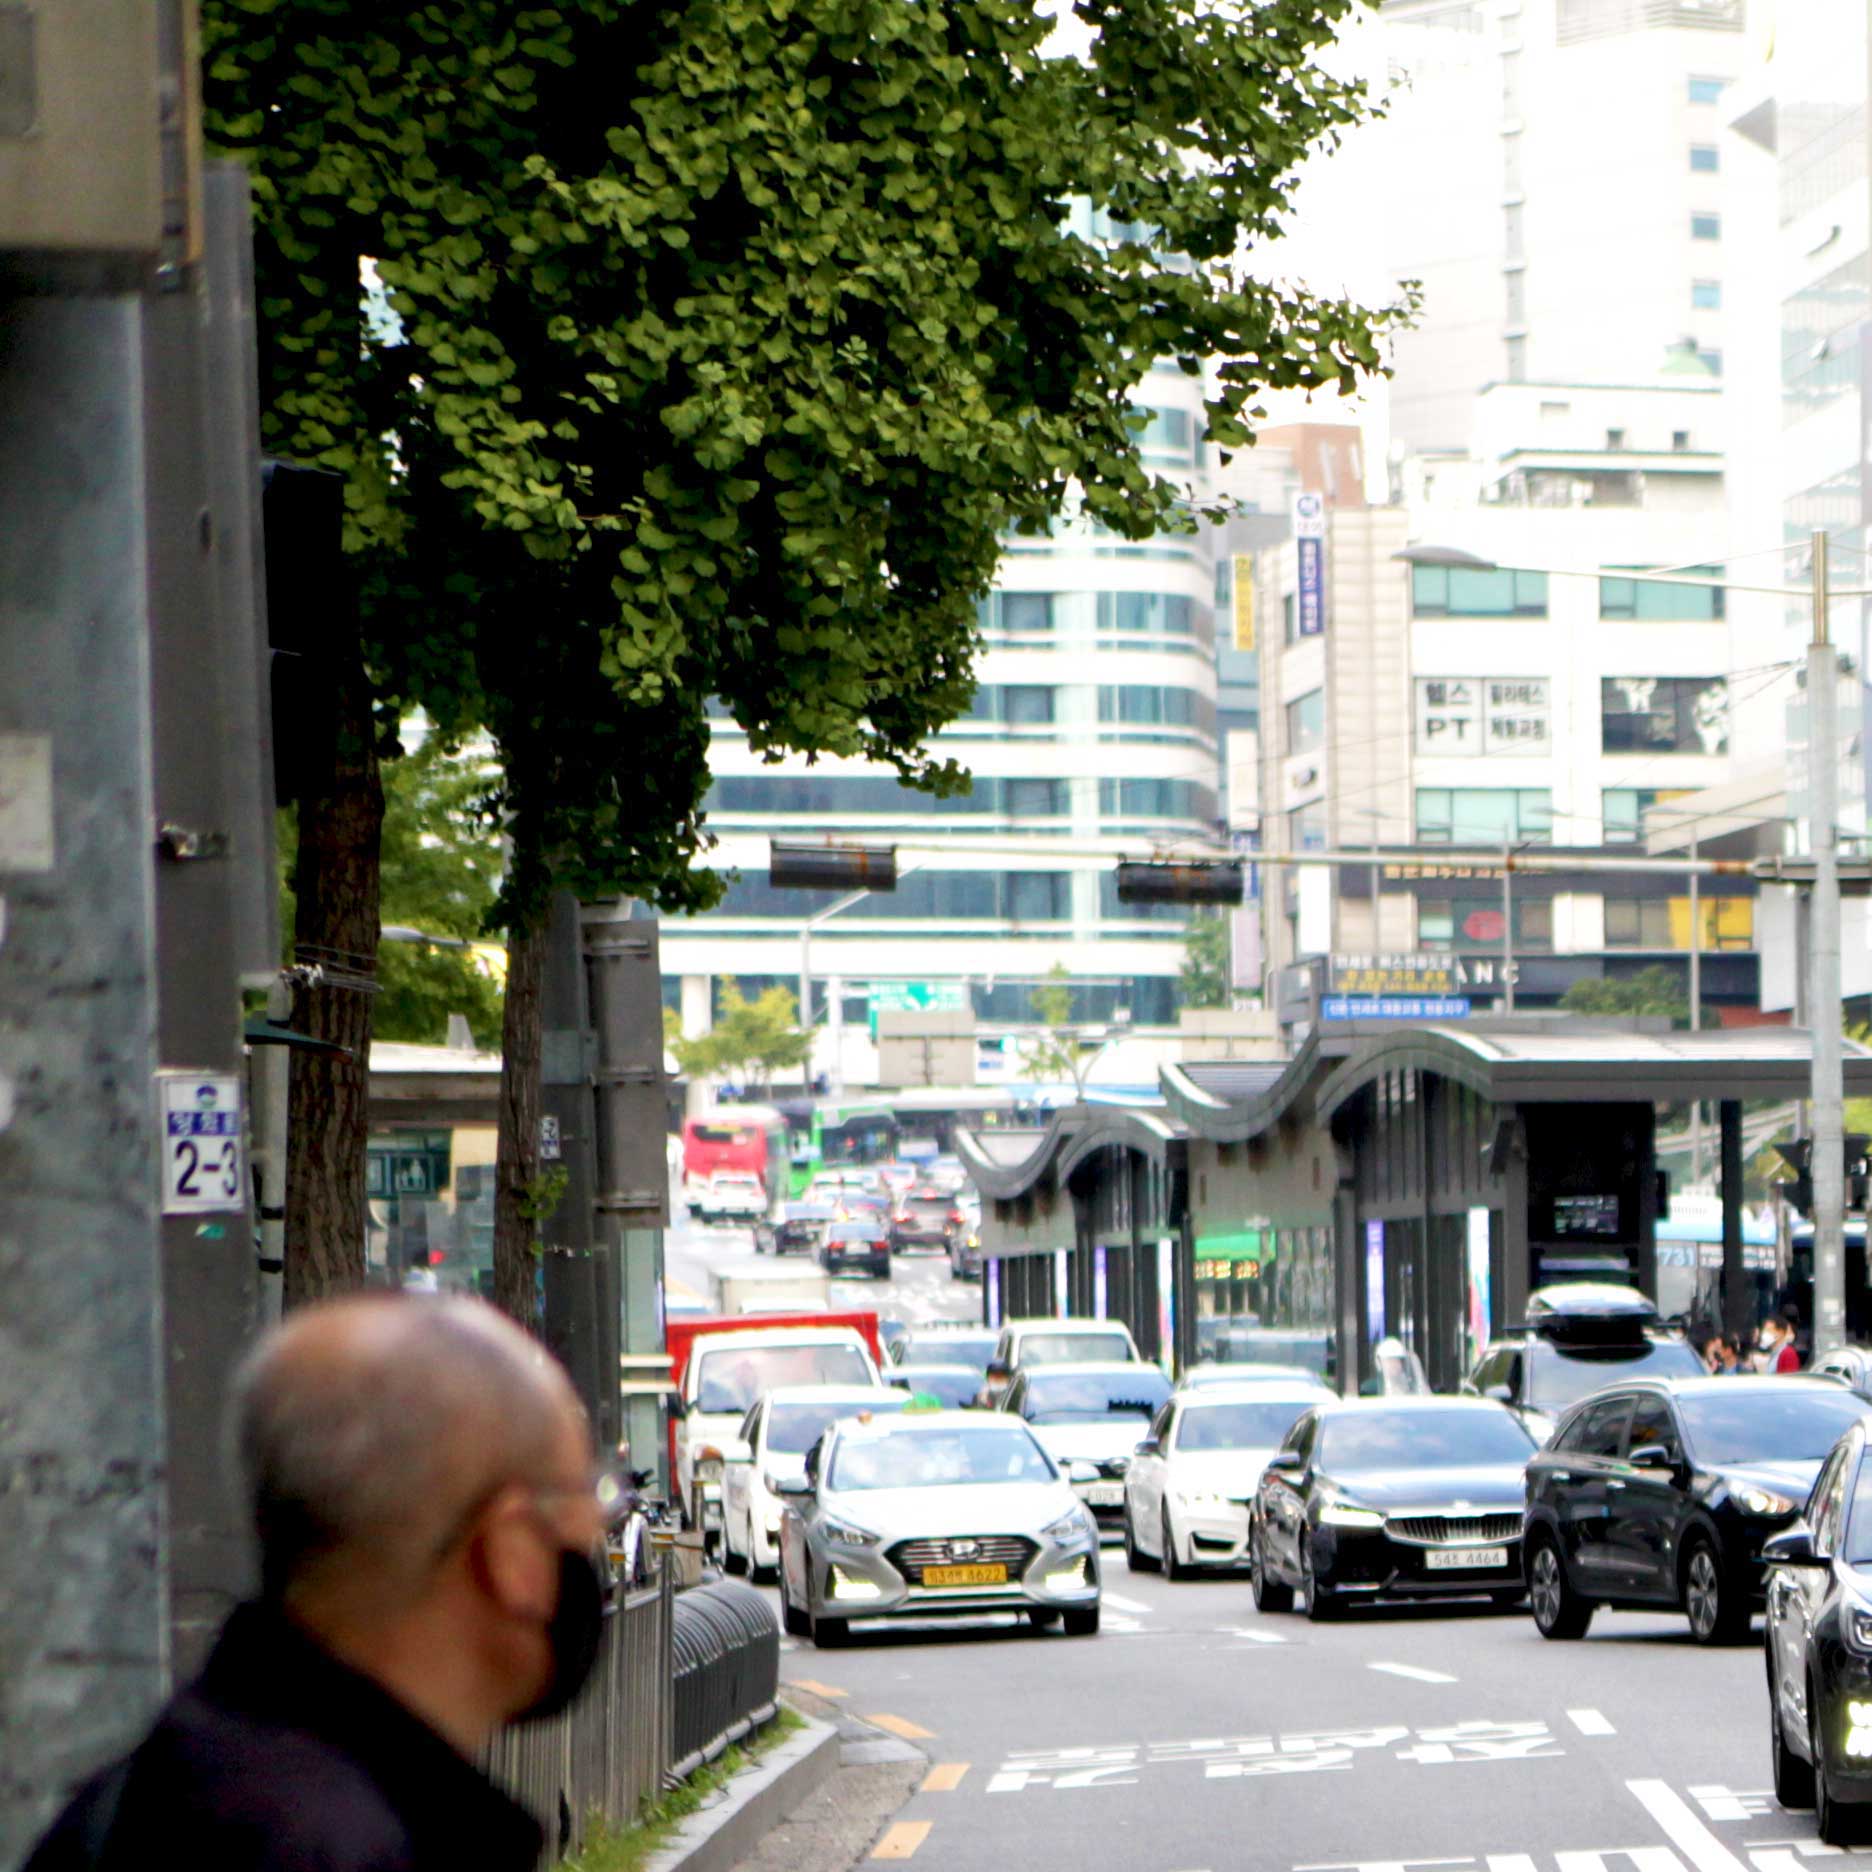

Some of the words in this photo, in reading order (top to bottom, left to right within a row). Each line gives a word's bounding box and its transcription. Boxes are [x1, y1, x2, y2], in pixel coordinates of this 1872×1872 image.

[1426, 682, 1472, 706] 헬스
[1426, 716, 1472, 741] PT
[175, 1139, 238, 1198] 2-3
